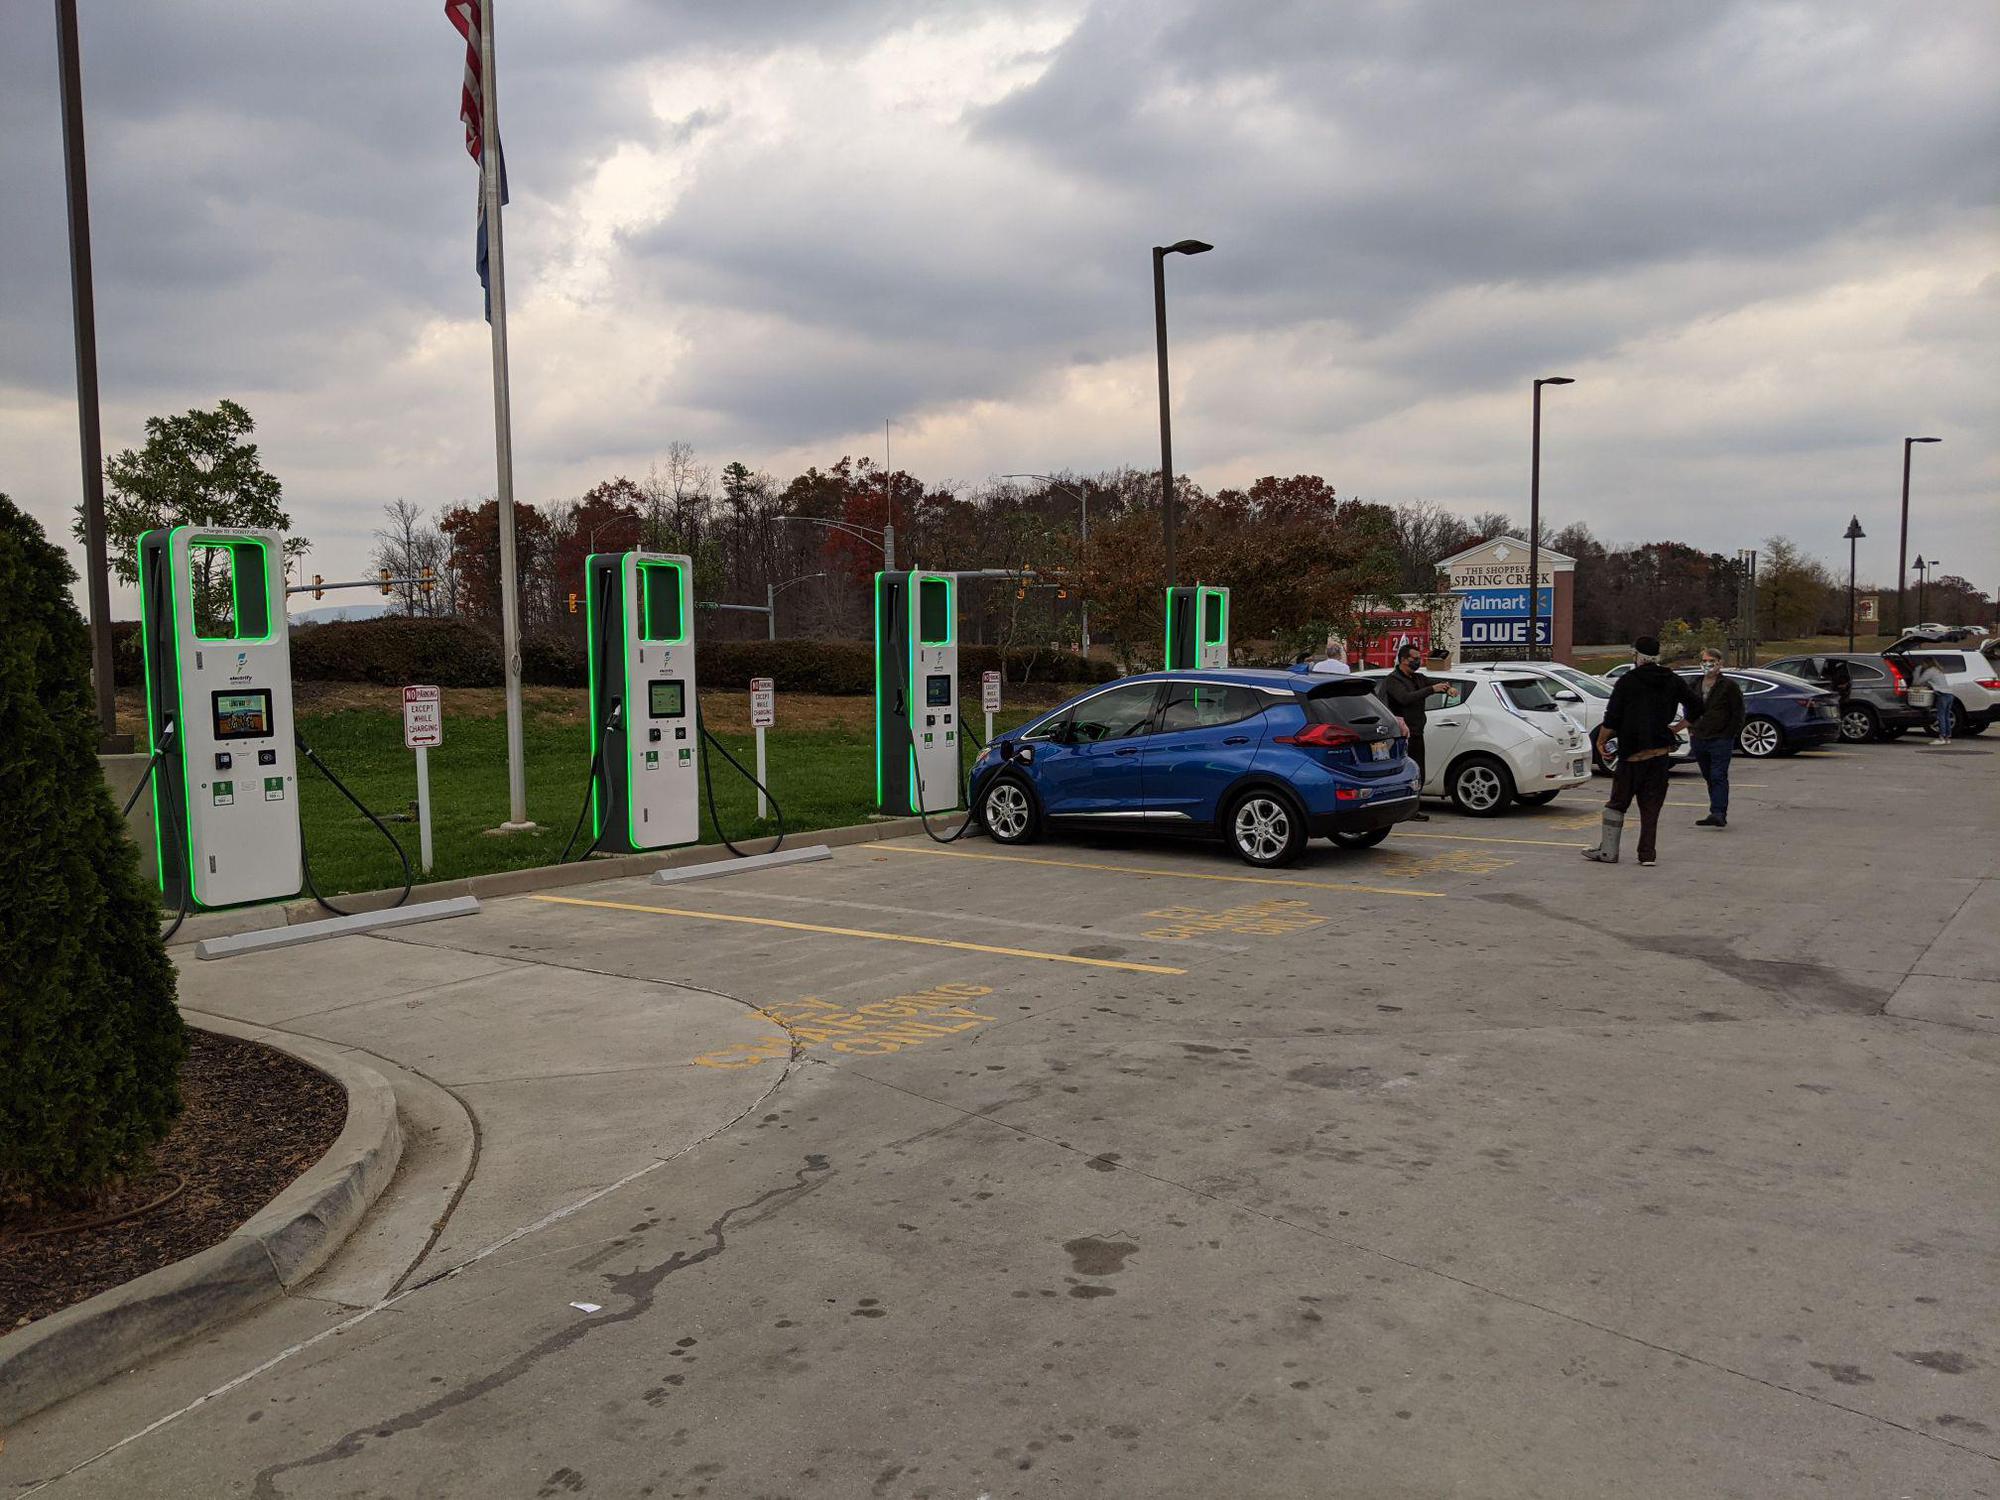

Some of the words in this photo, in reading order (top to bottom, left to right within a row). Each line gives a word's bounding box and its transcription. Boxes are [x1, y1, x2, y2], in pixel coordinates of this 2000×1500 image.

[1465, 567, 1483, 575] THE
[1486, 565, 1525, 574] SHOPPES
[1454, 575, 1502, 586] SPRING
[1506, 573, 1550, 585] CREK
[406, 689, 416, 701] NO
[411, 704, 434, 713] EXCEPT
[414, 714, 433, 722] WHILE
[409, 724, 438, 733] CHARGING
[692, 982, 994, 1070] CHARGING
[831, 1006, 998, 1056] ONLY
